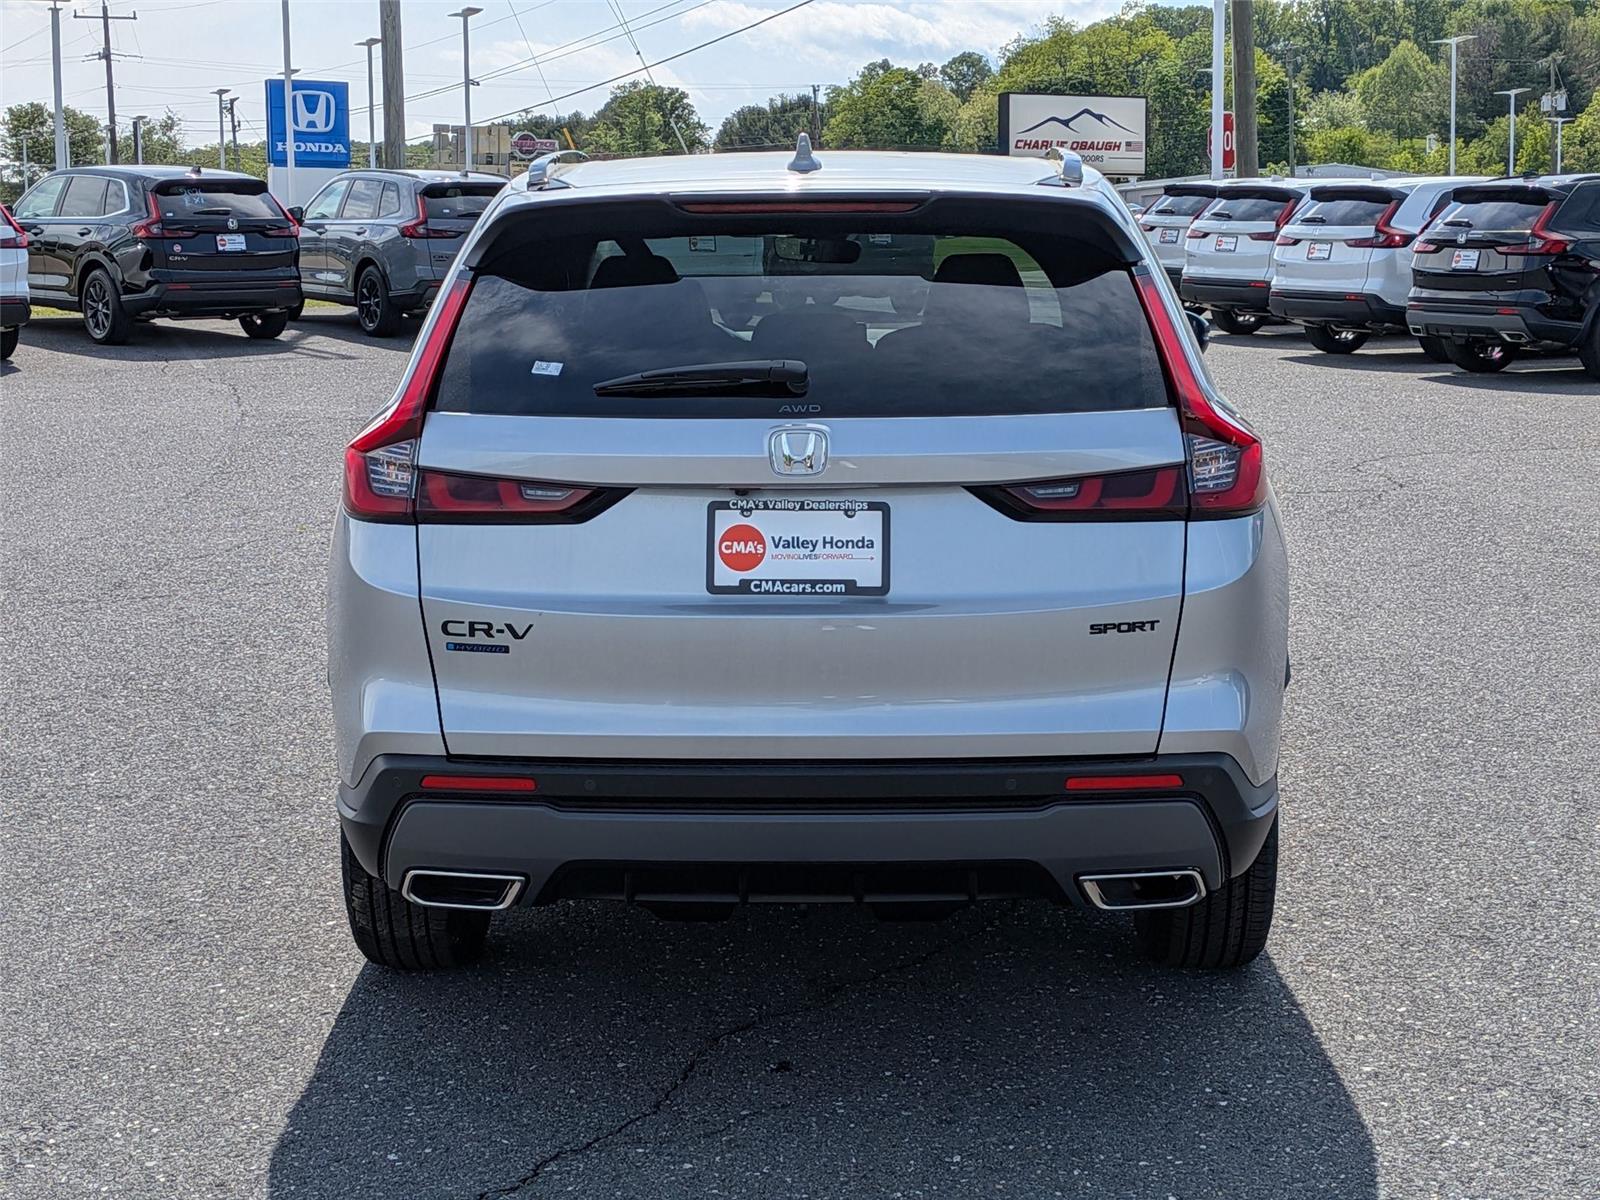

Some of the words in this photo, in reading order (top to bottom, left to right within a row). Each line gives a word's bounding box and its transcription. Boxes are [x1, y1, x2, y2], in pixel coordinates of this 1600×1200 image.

[276, 141, 348, 153] HONDA
[1070, 140, 1122, 151] OBAUGH
[778, 404, 821, 413] AWD
[729, 499, 764, 510] CMA's
[767, 499, 801, 511] Valley
[804, 500, 869, 511] Dealerships
[721, 541, 764, 554] CMA's
[771, 535, 819, 552] Valley
[822, 536, 875, 550] Honda
[750, 580, 846, 593] CMAcars.com
[441, 619, 534, 640] CR-V
[1089, 619, 1160, 635] SPORT
